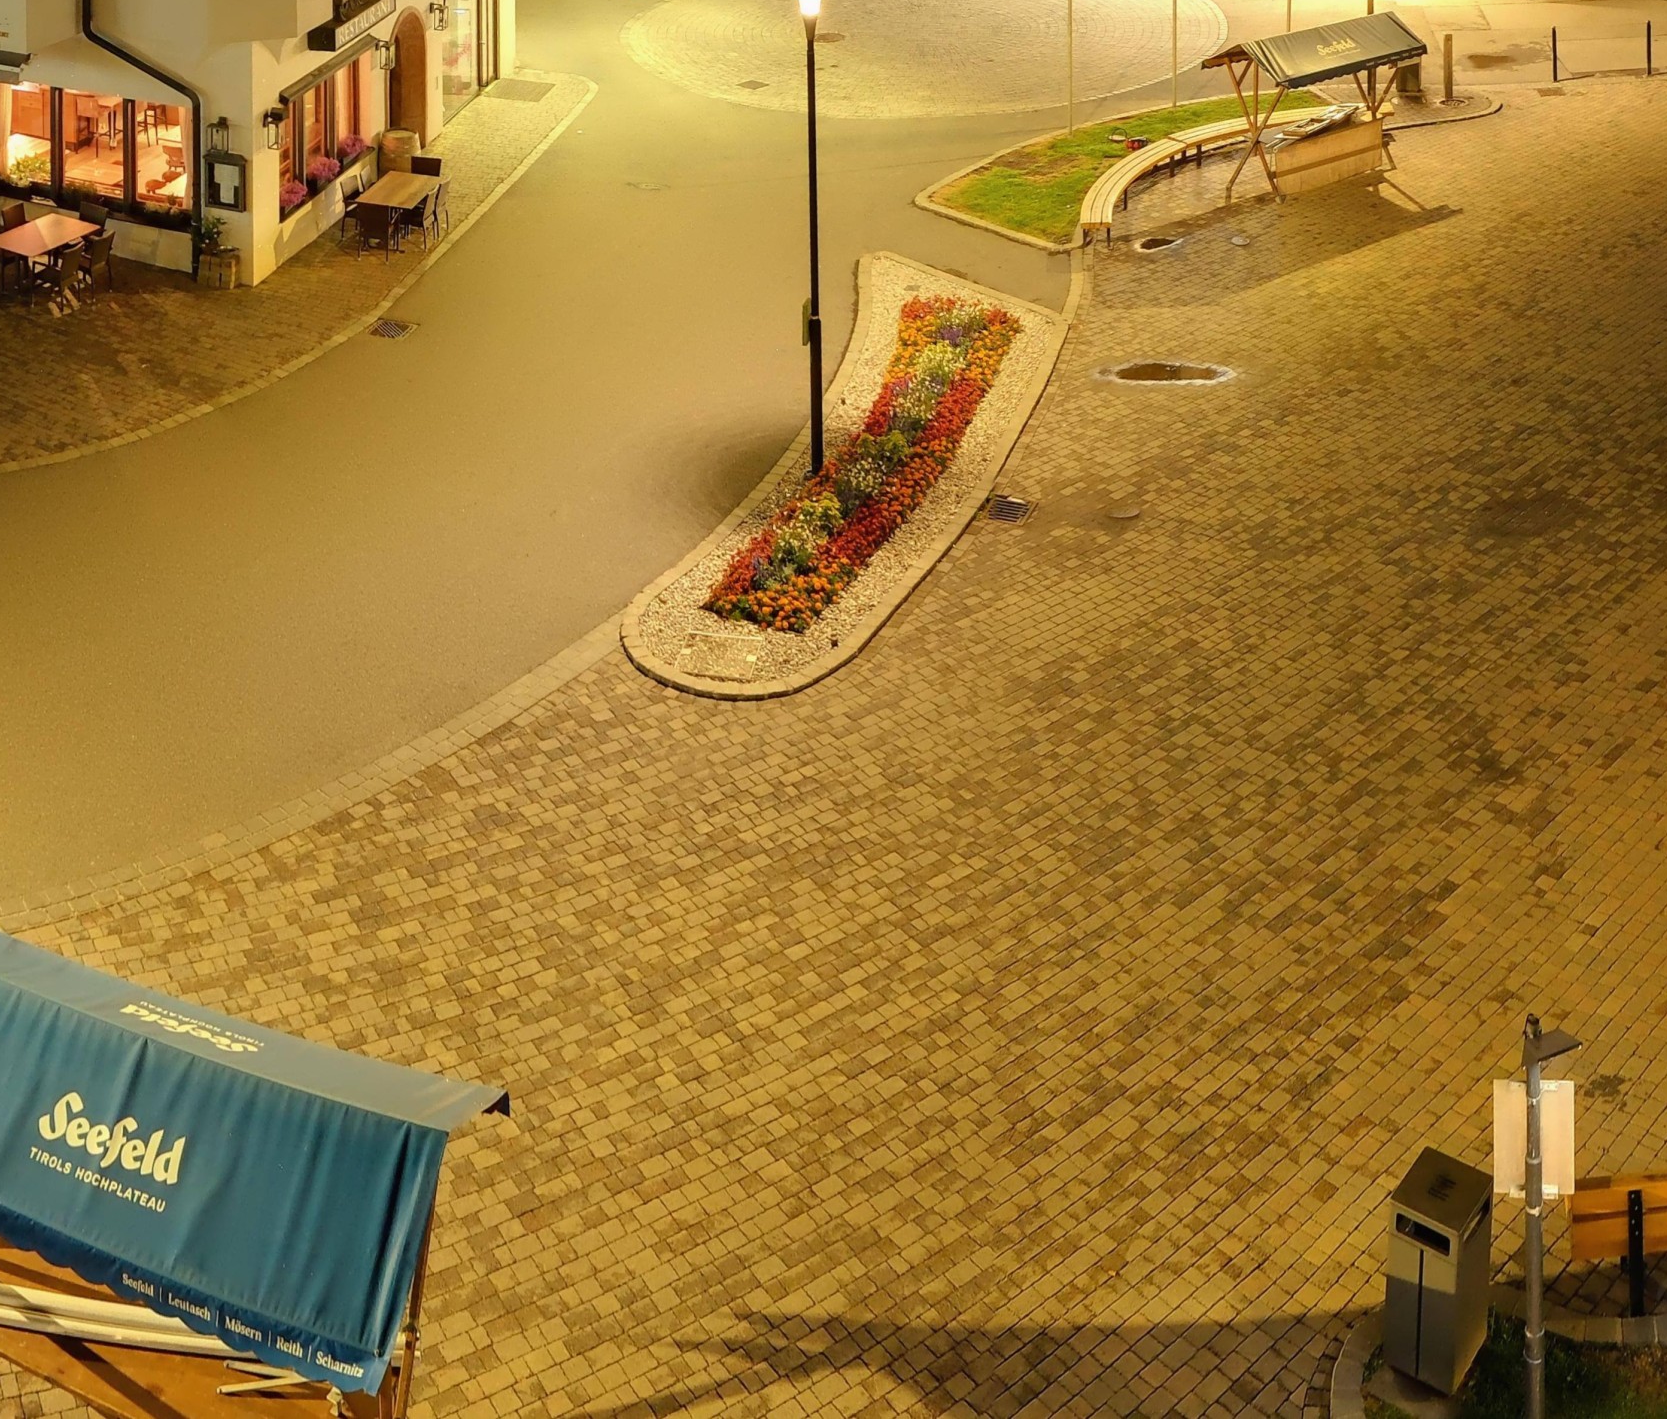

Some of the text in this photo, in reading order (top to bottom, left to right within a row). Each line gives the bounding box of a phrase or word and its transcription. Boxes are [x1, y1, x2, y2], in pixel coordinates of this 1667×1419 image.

[1316, 38, 1356, 56] Seefeld
[38, 1091, 186, 1185] Seefeld
[29, 1146, 167, 1213] TIROLS HOCHPLATEAU
[122, 1273, 365, 1378] Seefeld Leutasch Mösern Reith Scharnitz
